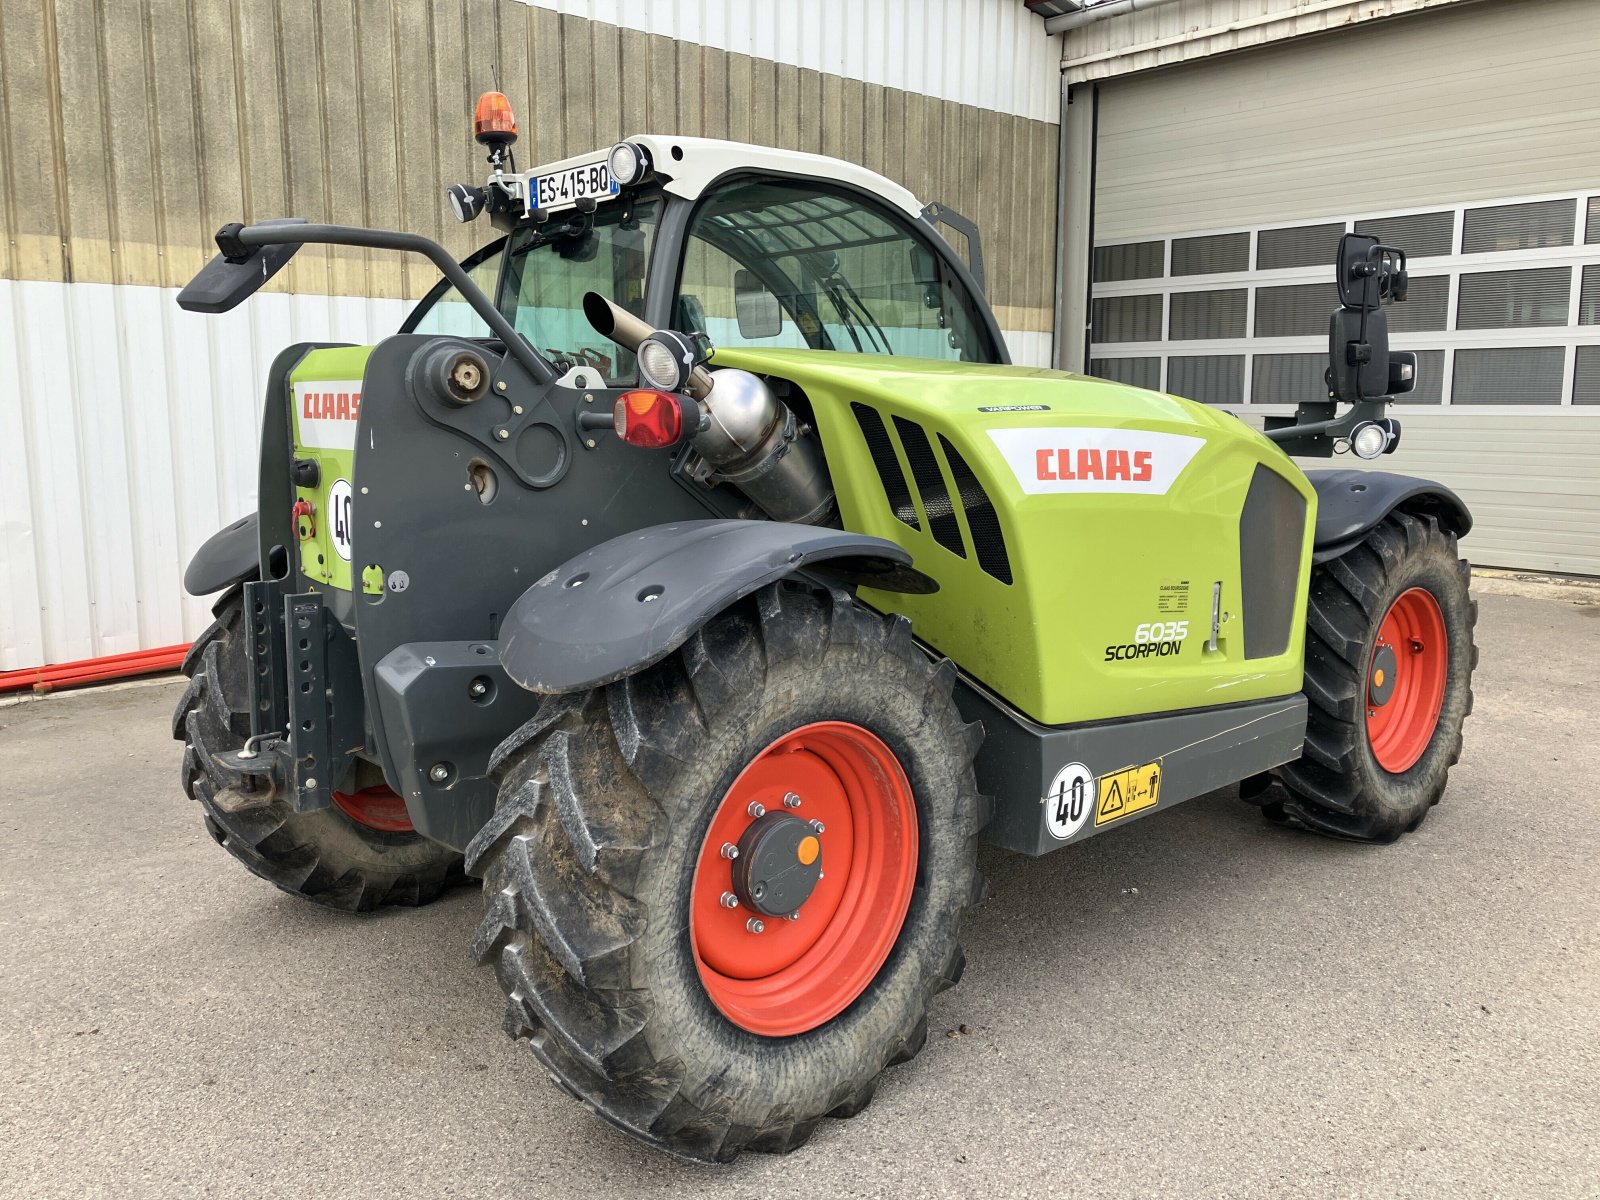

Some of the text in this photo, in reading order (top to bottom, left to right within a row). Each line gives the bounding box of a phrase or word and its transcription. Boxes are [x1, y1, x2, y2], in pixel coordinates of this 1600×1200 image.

[532, 197, 537, 206] F
[303, 393, 363, 421] CLAAS
[1035, 448, 1153, 482] CLAAS
[335, 494, 352, 546] 40
[1134, 621, 1189, 643] 6035
[1104, 640, 1182, 662] SCORPION
[1055, 775, 1085, 826] 40
